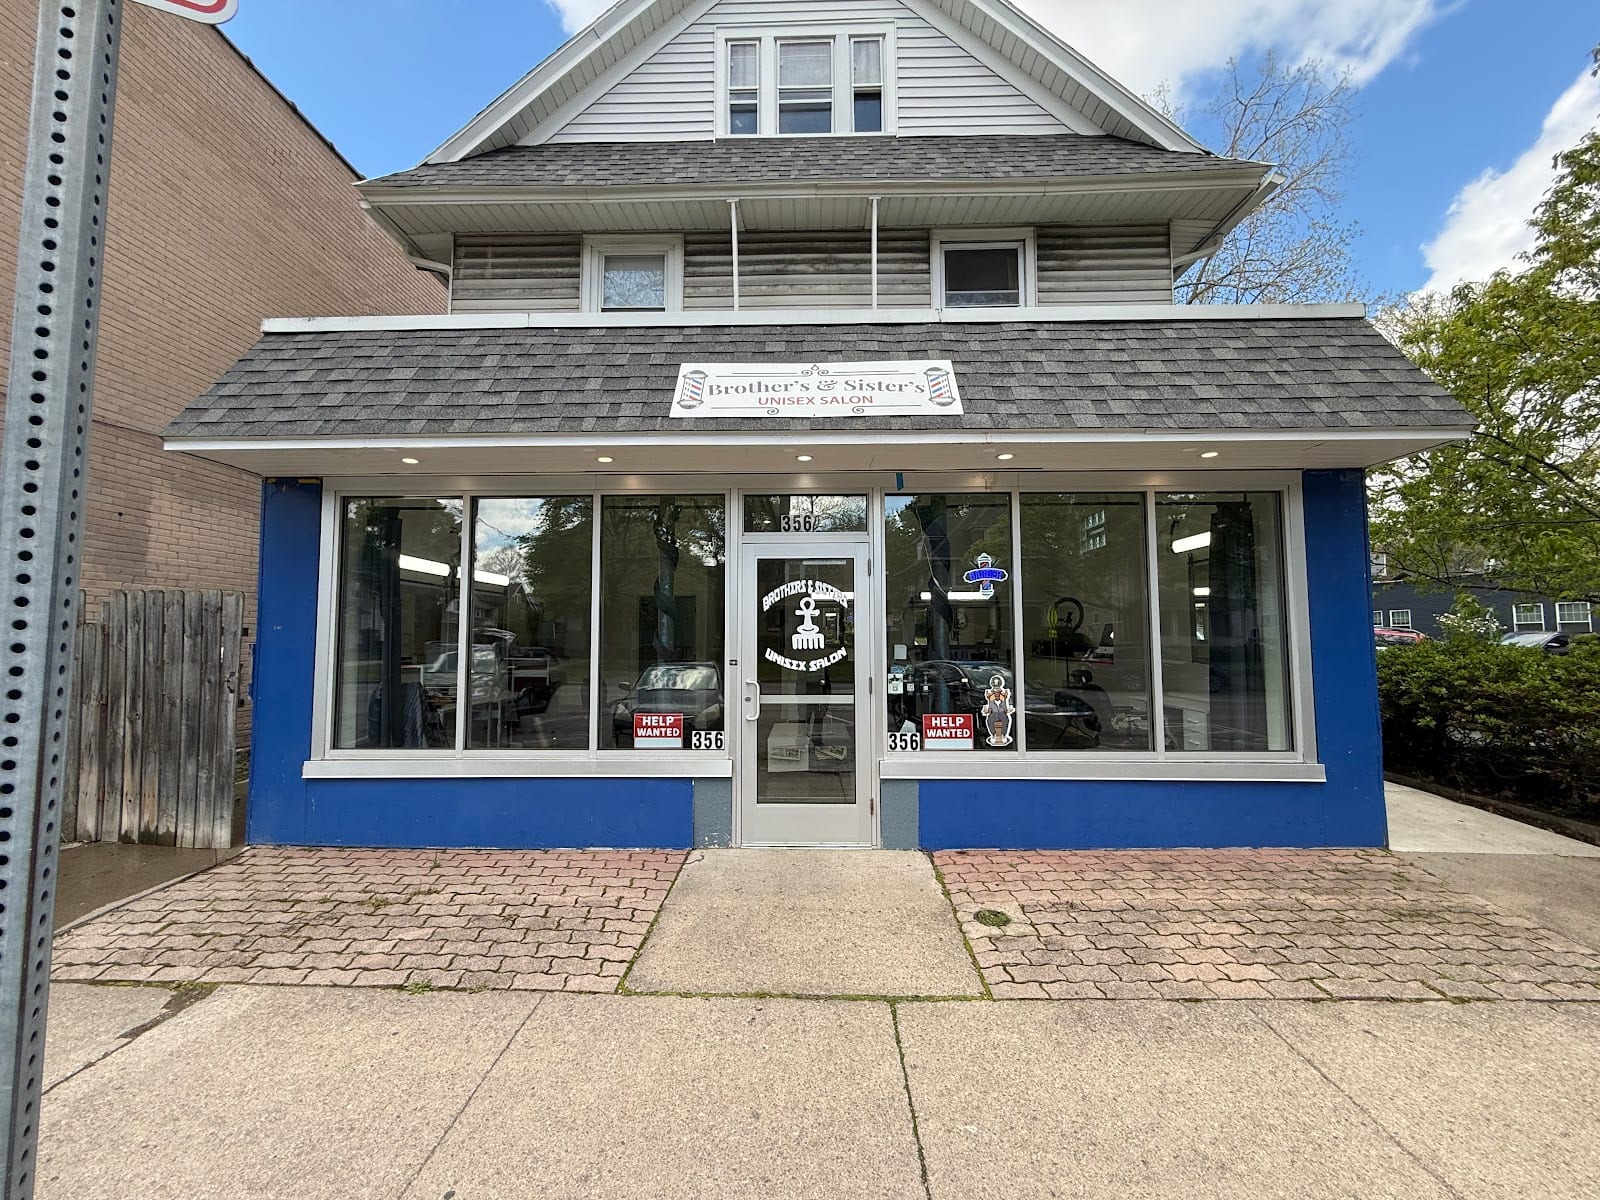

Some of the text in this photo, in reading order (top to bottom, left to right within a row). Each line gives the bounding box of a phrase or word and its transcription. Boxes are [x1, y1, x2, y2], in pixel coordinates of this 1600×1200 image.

[708, 379, 925, 396] Brother's & Sister's
[758, 395, 873, 406] UNISEX SALON
[762, 579, 807, 612] BROTHERS
[764, 646, 848, 672] UNISEX SALON
[642, 716, 674, 726] HELP
[931, 716, 965, 727] HELP
[637, 728, 680, 737] WANTED
[926, 729, 970, 738] WANTED
[693, 731, 723, 749] 356
[889, 733, 919, 751] 356
